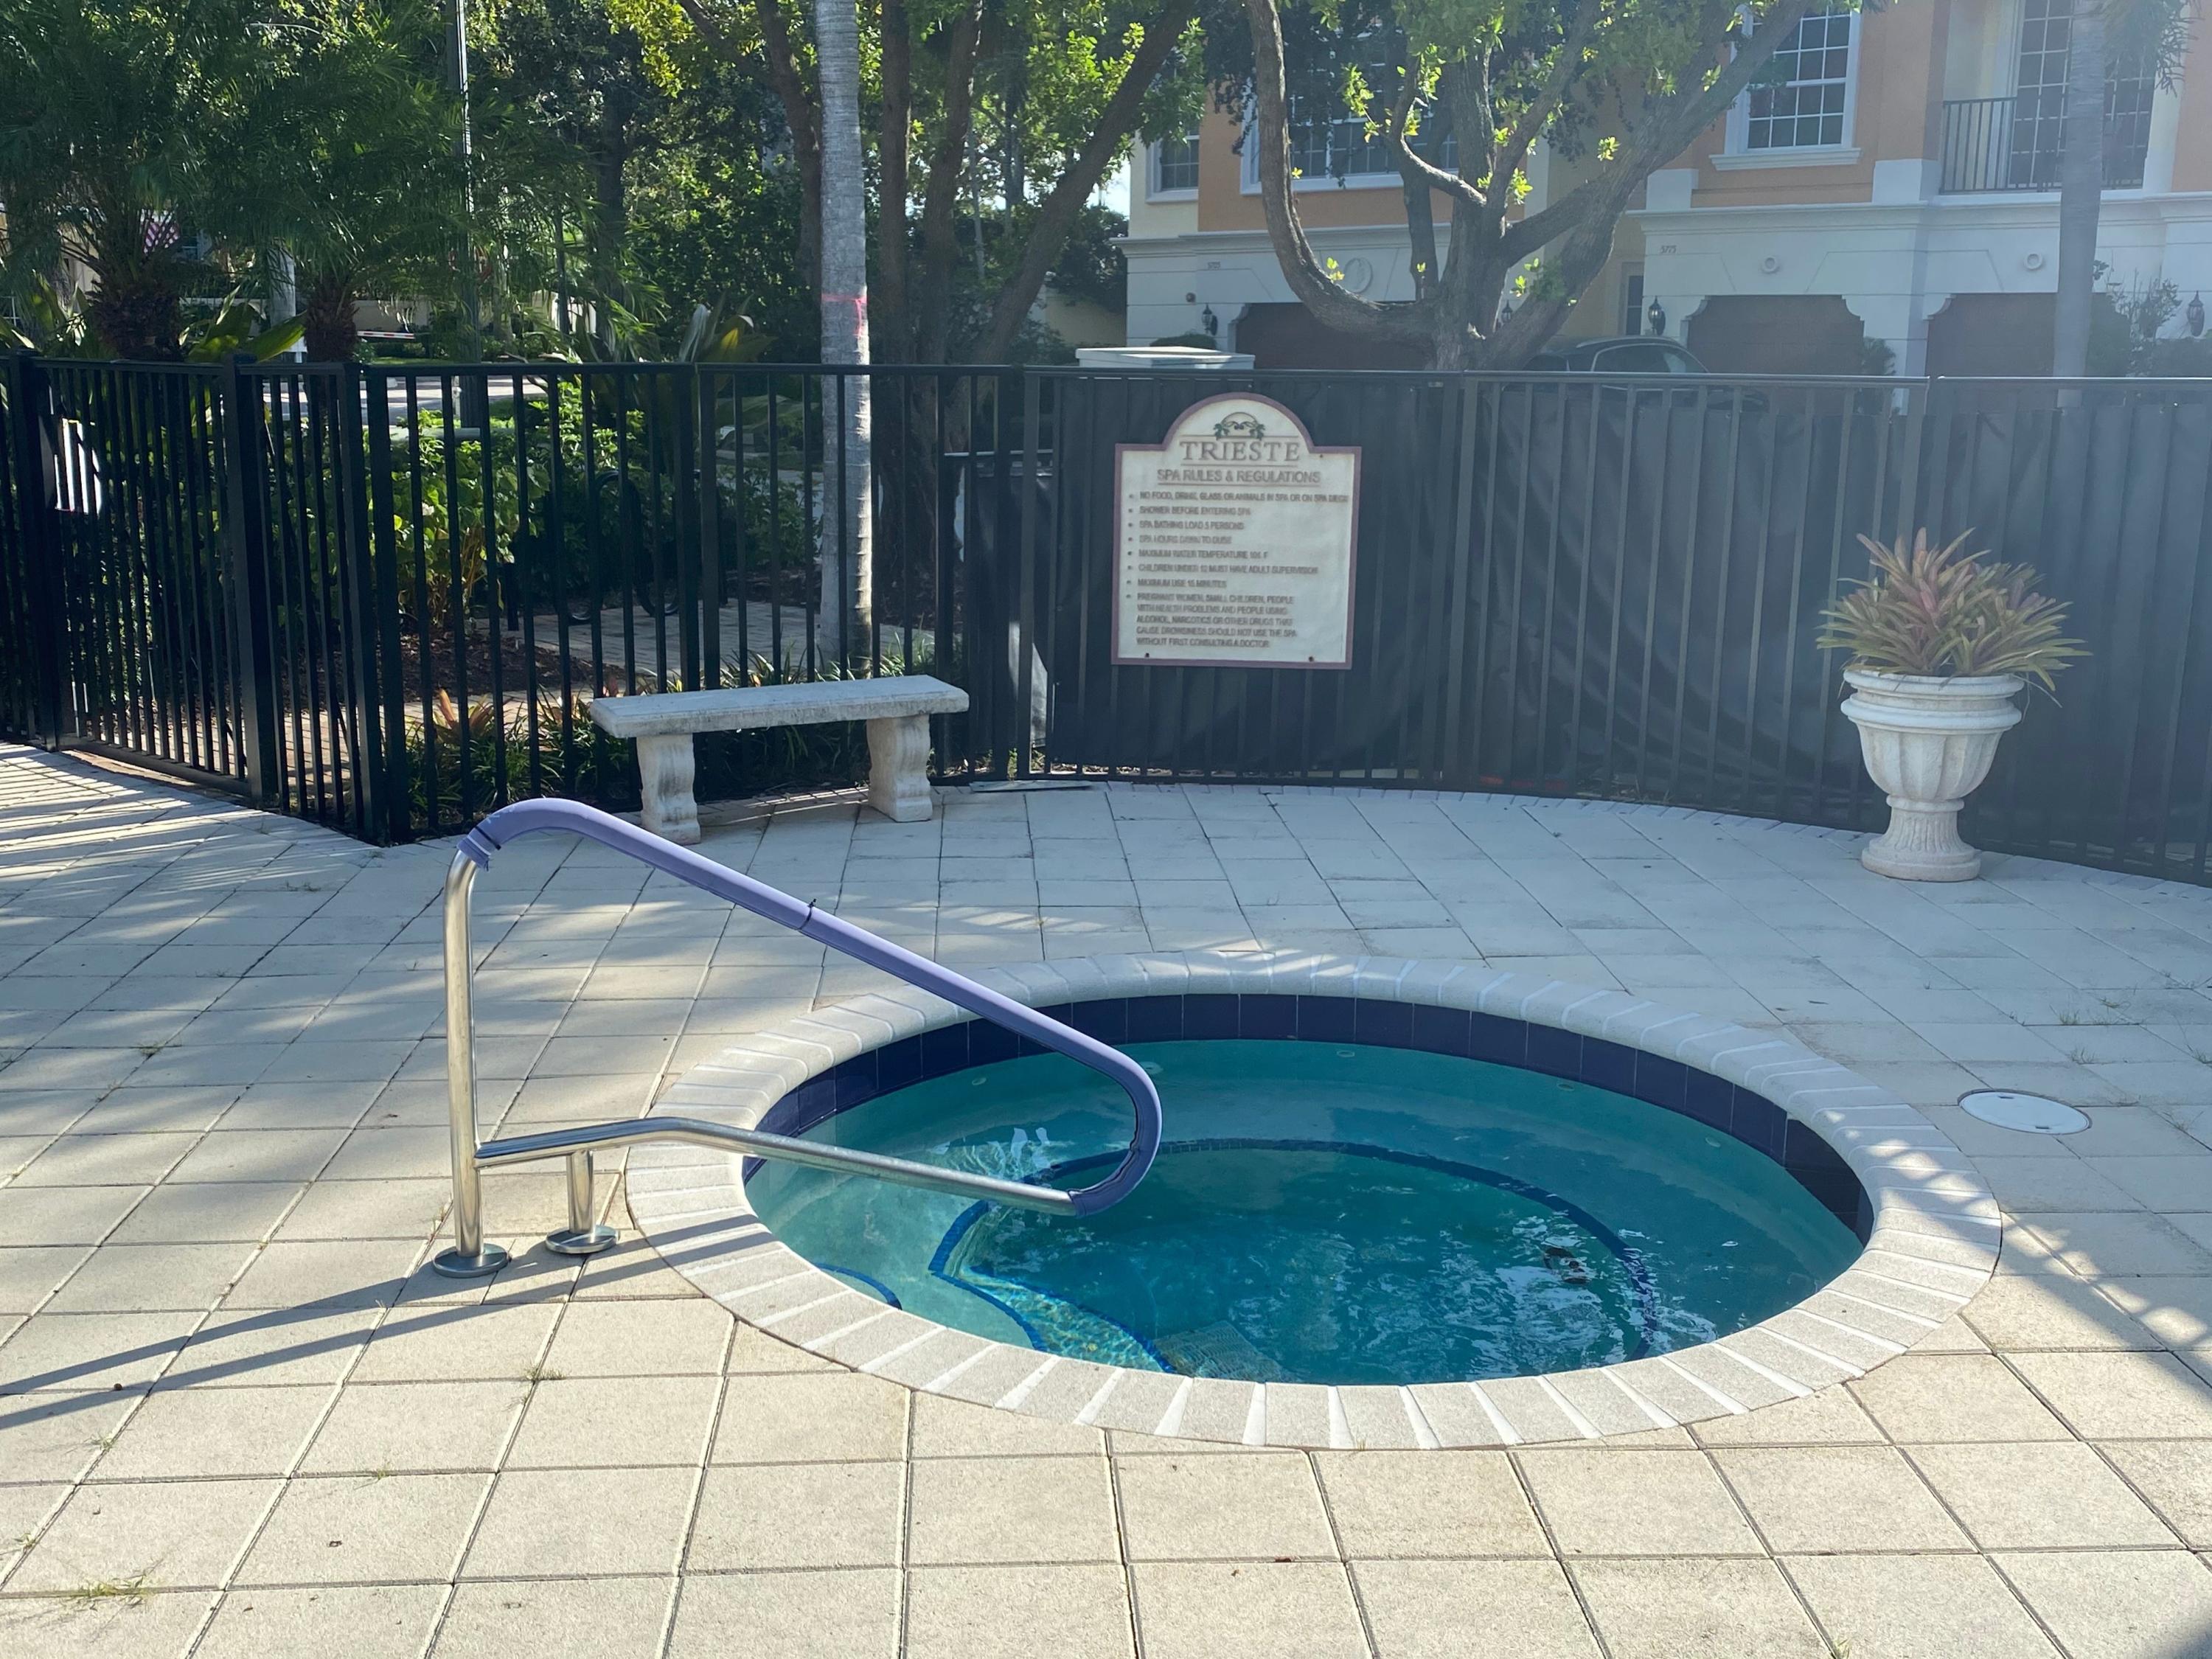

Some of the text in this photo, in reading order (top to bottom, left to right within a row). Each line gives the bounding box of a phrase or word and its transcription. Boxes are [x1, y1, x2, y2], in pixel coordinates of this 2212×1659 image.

[1180, 441, 1300, 462] TRIESTE
[1157, 469, 1321, 483] SPA RULES & REGULATIONS
[1140, 491, 1150, 500] NO
[1200, 492, 1222, 501] GLASS
[1223, 493, 1235, 501] OR
[1236, 493, 1265, 501] ANIMALS
[1267, 493, 1273, 501] IN
[1275, 493, 1289, 502] SPA
[1290, 493, 1301, 502] OR
[1302, 494, 1312, 502] ON
[1314, 494, 1326, 502] SPA
[1140, 506, 1251, 515] SHOWER BEFORE ENTERING SPA
[1139, 520, 1153, 529] SPA
[1154, 521, 1183, 529] BATHING
[1185, 521, 1203, 529] LOAD
[1210, 521, 1244, 530] PERSONS
[1139, 535, 1152, 543] SPA
[1154, 535, 1178, 543] HOURS
[1201, 536, 1211, 544] TO
[1138, 549, 1171, 557] MAXIMUM
[1172, 550, 1197, 558] WATER
[1197, 550, 1248, 559] TEMPERATURE
[1138, 563, 1173, 572] CHILDREN
[1175, 564, 1199, 573] UNDER
[1208, 565, 1228, 573] MUST
[1230, 565, 1247, 574] HAVE
[1248, 566, 1270, 574] ADULT
[1272, 566, 1318, 574] SUPERVISION
[1138, 578, 1170, 587] MAXIMUM
[1172, 579, 1186, 587] USE
[1196, 580, 1227, 588] MINUTES
[1137, 593, 1175, 602] PREGNANT
[1206, 594, 1228, 602] SMALL
[1267, 595, 1293, 604] PEOPLE
[1137, 604, 1287, 616] WITH HEALTH PROBLEMS AND PEOPLE USING
[1172, 616, 1211, 625] NARCOTICS
[1213, 616, 1223, 625] OR
[1224, 617, 1248, 625] OTHER
[1250, 618, 1273, 626] DRUGS
[1276, 619, 1293, 627] THAT
[1136, 626, 1297, 639] CAUSE DROWSINESS SHOULD NOT USE THE SPA
[1136, 636, 1166, 645] WITHOUT
[1168, 637, 1188, 646] FIRST
[1189, 638, 1233, 647] CONSULTING
[1240, 639, 1270, 648] DOCTOR
